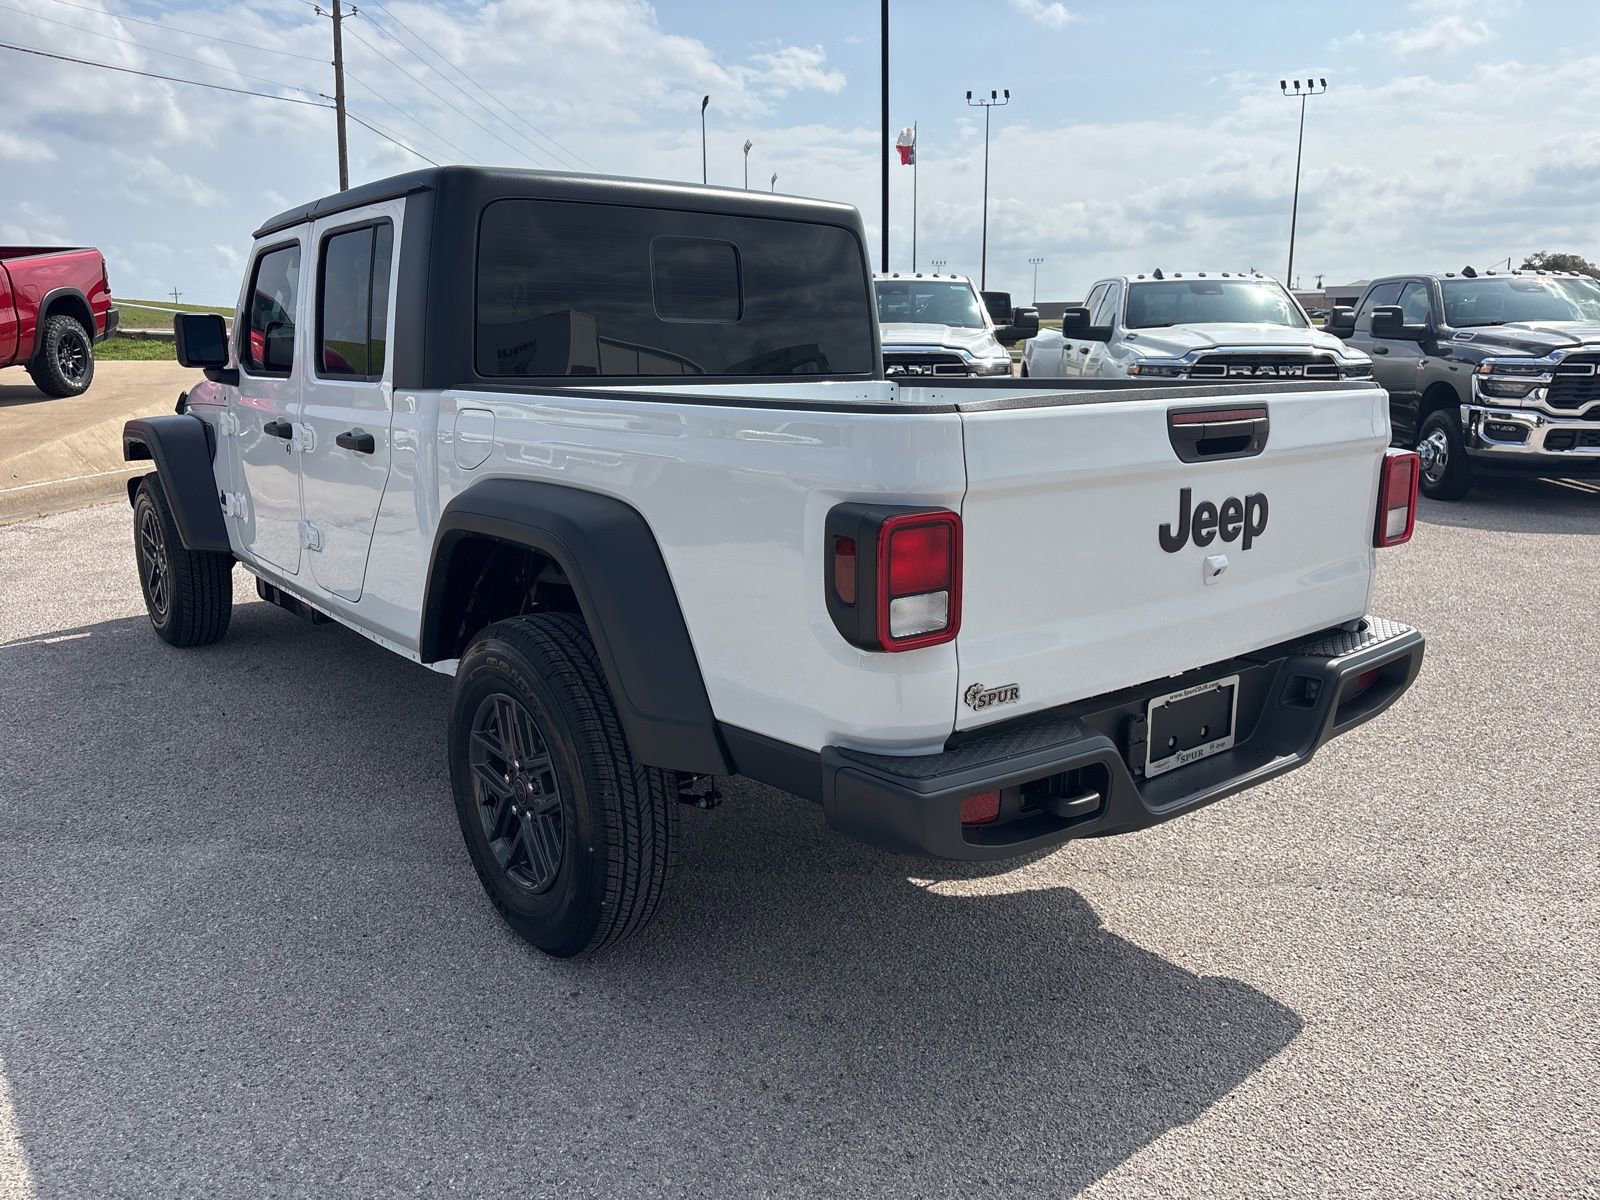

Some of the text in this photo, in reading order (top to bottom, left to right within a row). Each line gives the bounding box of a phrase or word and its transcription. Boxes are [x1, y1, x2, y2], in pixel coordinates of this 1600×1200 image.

[885, 365, 932, 375] AM
[1229, 365, 1303, 376] RAM
[1158, 487, 1269, 553] Jeep
[978, 687, 1019, 708] SPUR
[1180, 749, 1204, 763] SPUR
